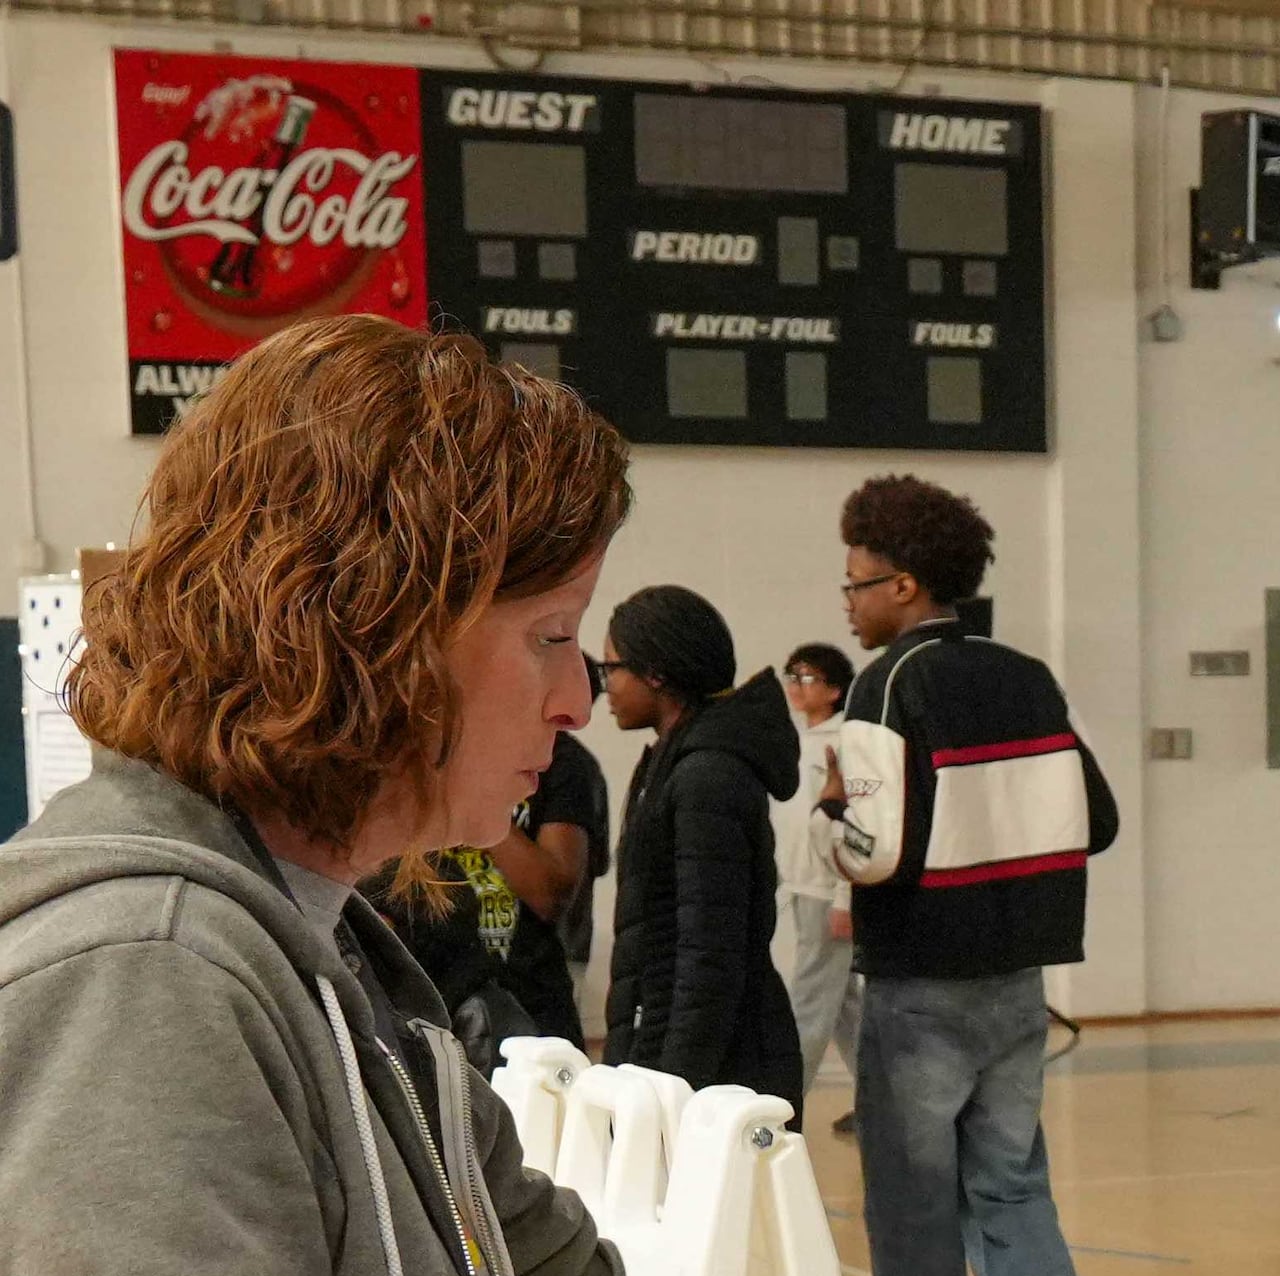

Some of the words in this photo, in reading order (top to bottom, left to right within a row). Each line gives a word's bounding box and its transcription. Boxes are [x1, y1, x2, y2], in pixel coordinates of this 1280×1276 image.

[448, 86, 597, 132] GUEST
[890, 113, 1012, 154] HOME
[123, 140, 418, 249] Coca-Cola
[632, 231, 758, 265] PERIOD
[484, 307, 574, 334] FOULS
[654, 312, 838, 343] PLAYER-FOUL
[912, 321, 995, 347] FOULS
[135, 364, 228, 396] ALW
